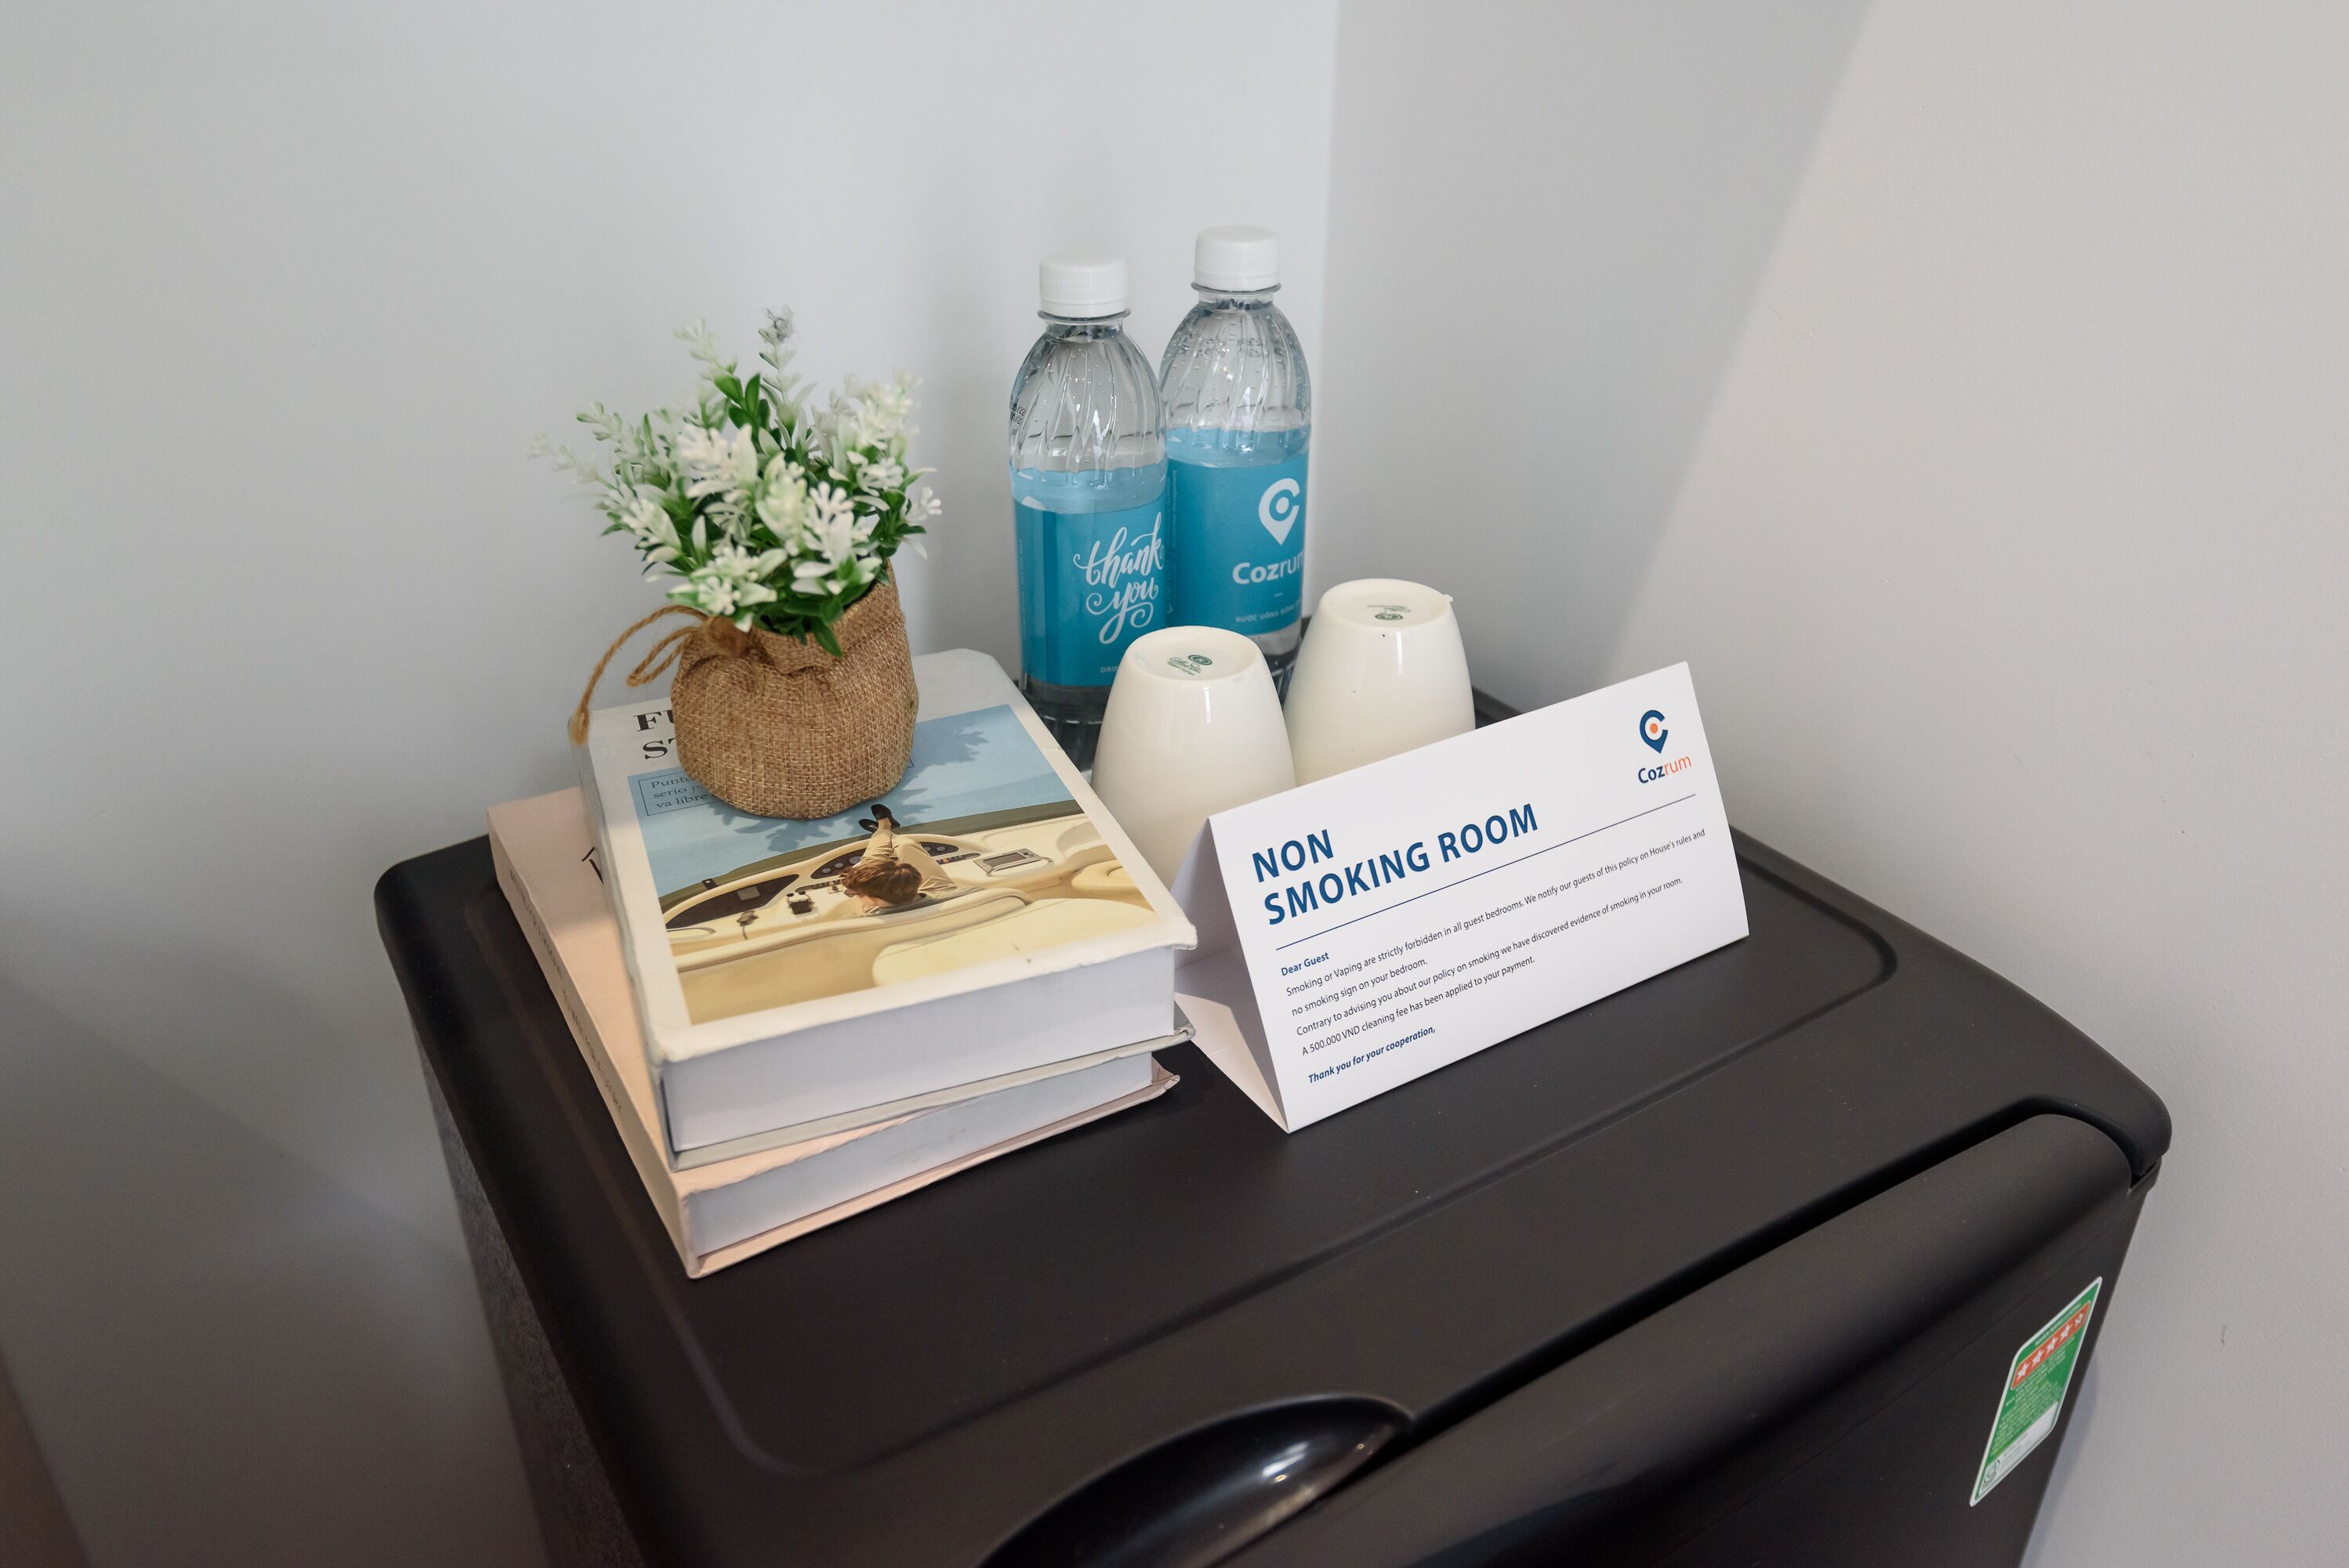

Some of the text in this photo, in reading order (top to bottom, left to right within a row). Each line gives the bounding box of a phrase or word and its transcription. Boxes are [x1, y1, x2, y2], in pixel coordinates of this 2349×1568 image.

[1073, 511, 1165, 588] thank
[1086, 578, 1158, 644] you
[653, 788, 687, 798] serio
[1637, 755, 1692, 784] Cozrum
[656, 800, 672, 809] va
[1252, 828, 1334, 883] NON
[1263, 802, 1539, 925] SMOKING ROOM
[1286, 977, 1323, 997] Smoking
[1324, 973, 1332, 982] or
[1333, 962, 1363, 978] Vaping
[1363, 957, 1376, 967] are
[1377, 945, 1404, 961] strictly
[1405, 931, 1443, 951] forbidden
[1443, 928, 1452, 936] in
[1453, 922, 1463, 932] all
[1463, 914, 1484, 931] guest
[1484, 900, 1524, 920] bedrooms.
[1524, 895, 1537, 905] We
[1537, 885, 1558, 900] notify
[1559, 882, 1571, 892] our
[1572, 872, 1596, 889] guests
[1596, 867, 1604, 877] of
[1604, 864, 1618, 875] this
[1618, 856, 1638, 871] policy
[1640, 852, 1649, 860] on
[1676, 835, 1692, 846] rules
[1693, 827, 1706, 840] and
[1281, 952, 1330, 976] Dear Guest
[1296, 878, 1683, 1036] Contrary to advising you about our policy on smoking we have discovered evidence of smoking in your room.
[1292, 959, 1428, 1016] no smoking sign on your bedroom.
[1302, 1046, 1309, 1056] A
[1310, 1033, 1342, 1053] 500.000
[1341, 1025, 1361, 1039] VND
[1361, 1013, 1395, 1031] cleaning
[1395, 1008, 1408, 1018] fee
[1408, 1001, 1423, 1012] has
[1423, 993, 1444, 1006] been
[1445, 979, 1474, 998] applied
[1483, 970, 1500, 985] your
[1501, 956, 1535, 977] payment.
[1307, 1027, 1436, 1084] Thank you for your cooperation,
